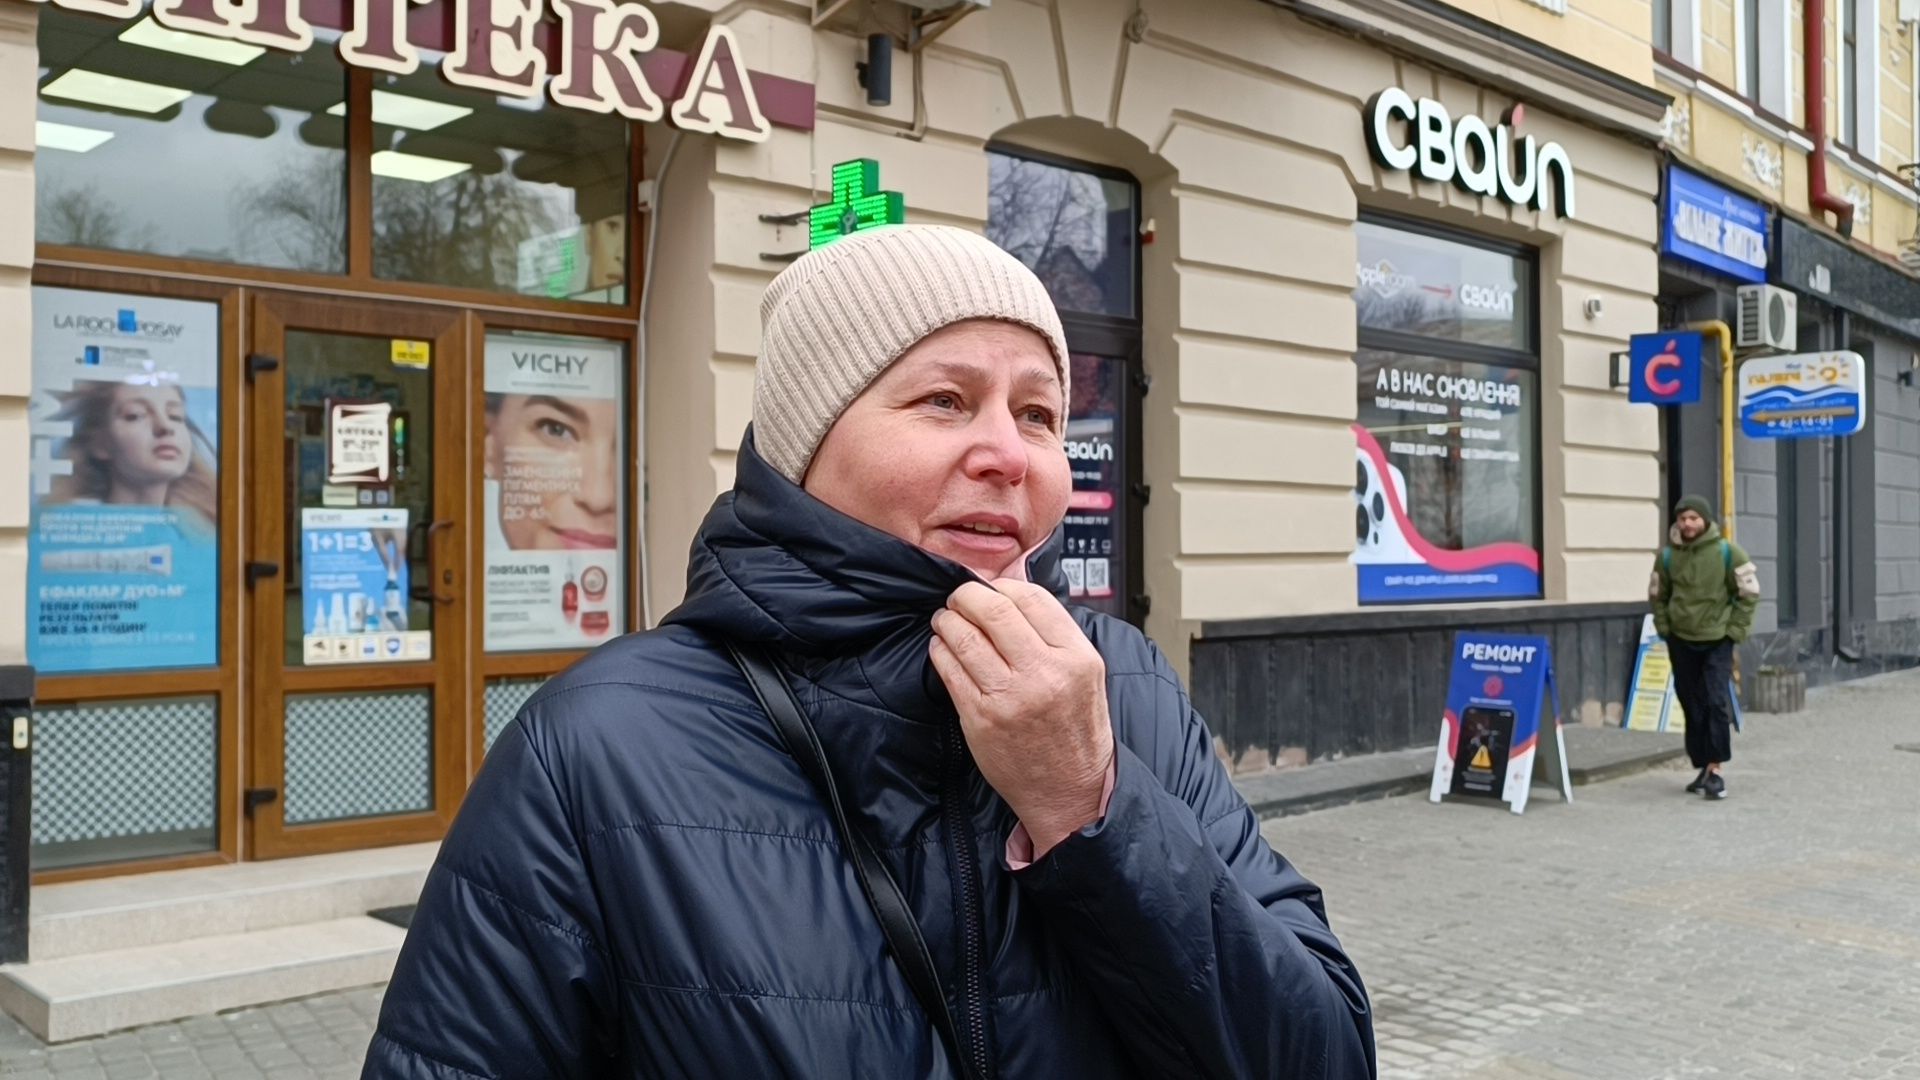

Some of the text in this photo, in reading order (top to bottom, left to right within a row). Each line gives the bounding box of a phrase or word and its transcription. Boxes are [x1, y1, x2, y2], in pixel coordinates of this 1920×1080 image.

[512, 352, 588, 375] VICHY
[1376, 367, 1521, 407] А В НАС ОНОВЛЕННЯ
[309, 531, 374, 553] 1+1=3
[1462, 642, 1537, 663] РЕМОНТ
